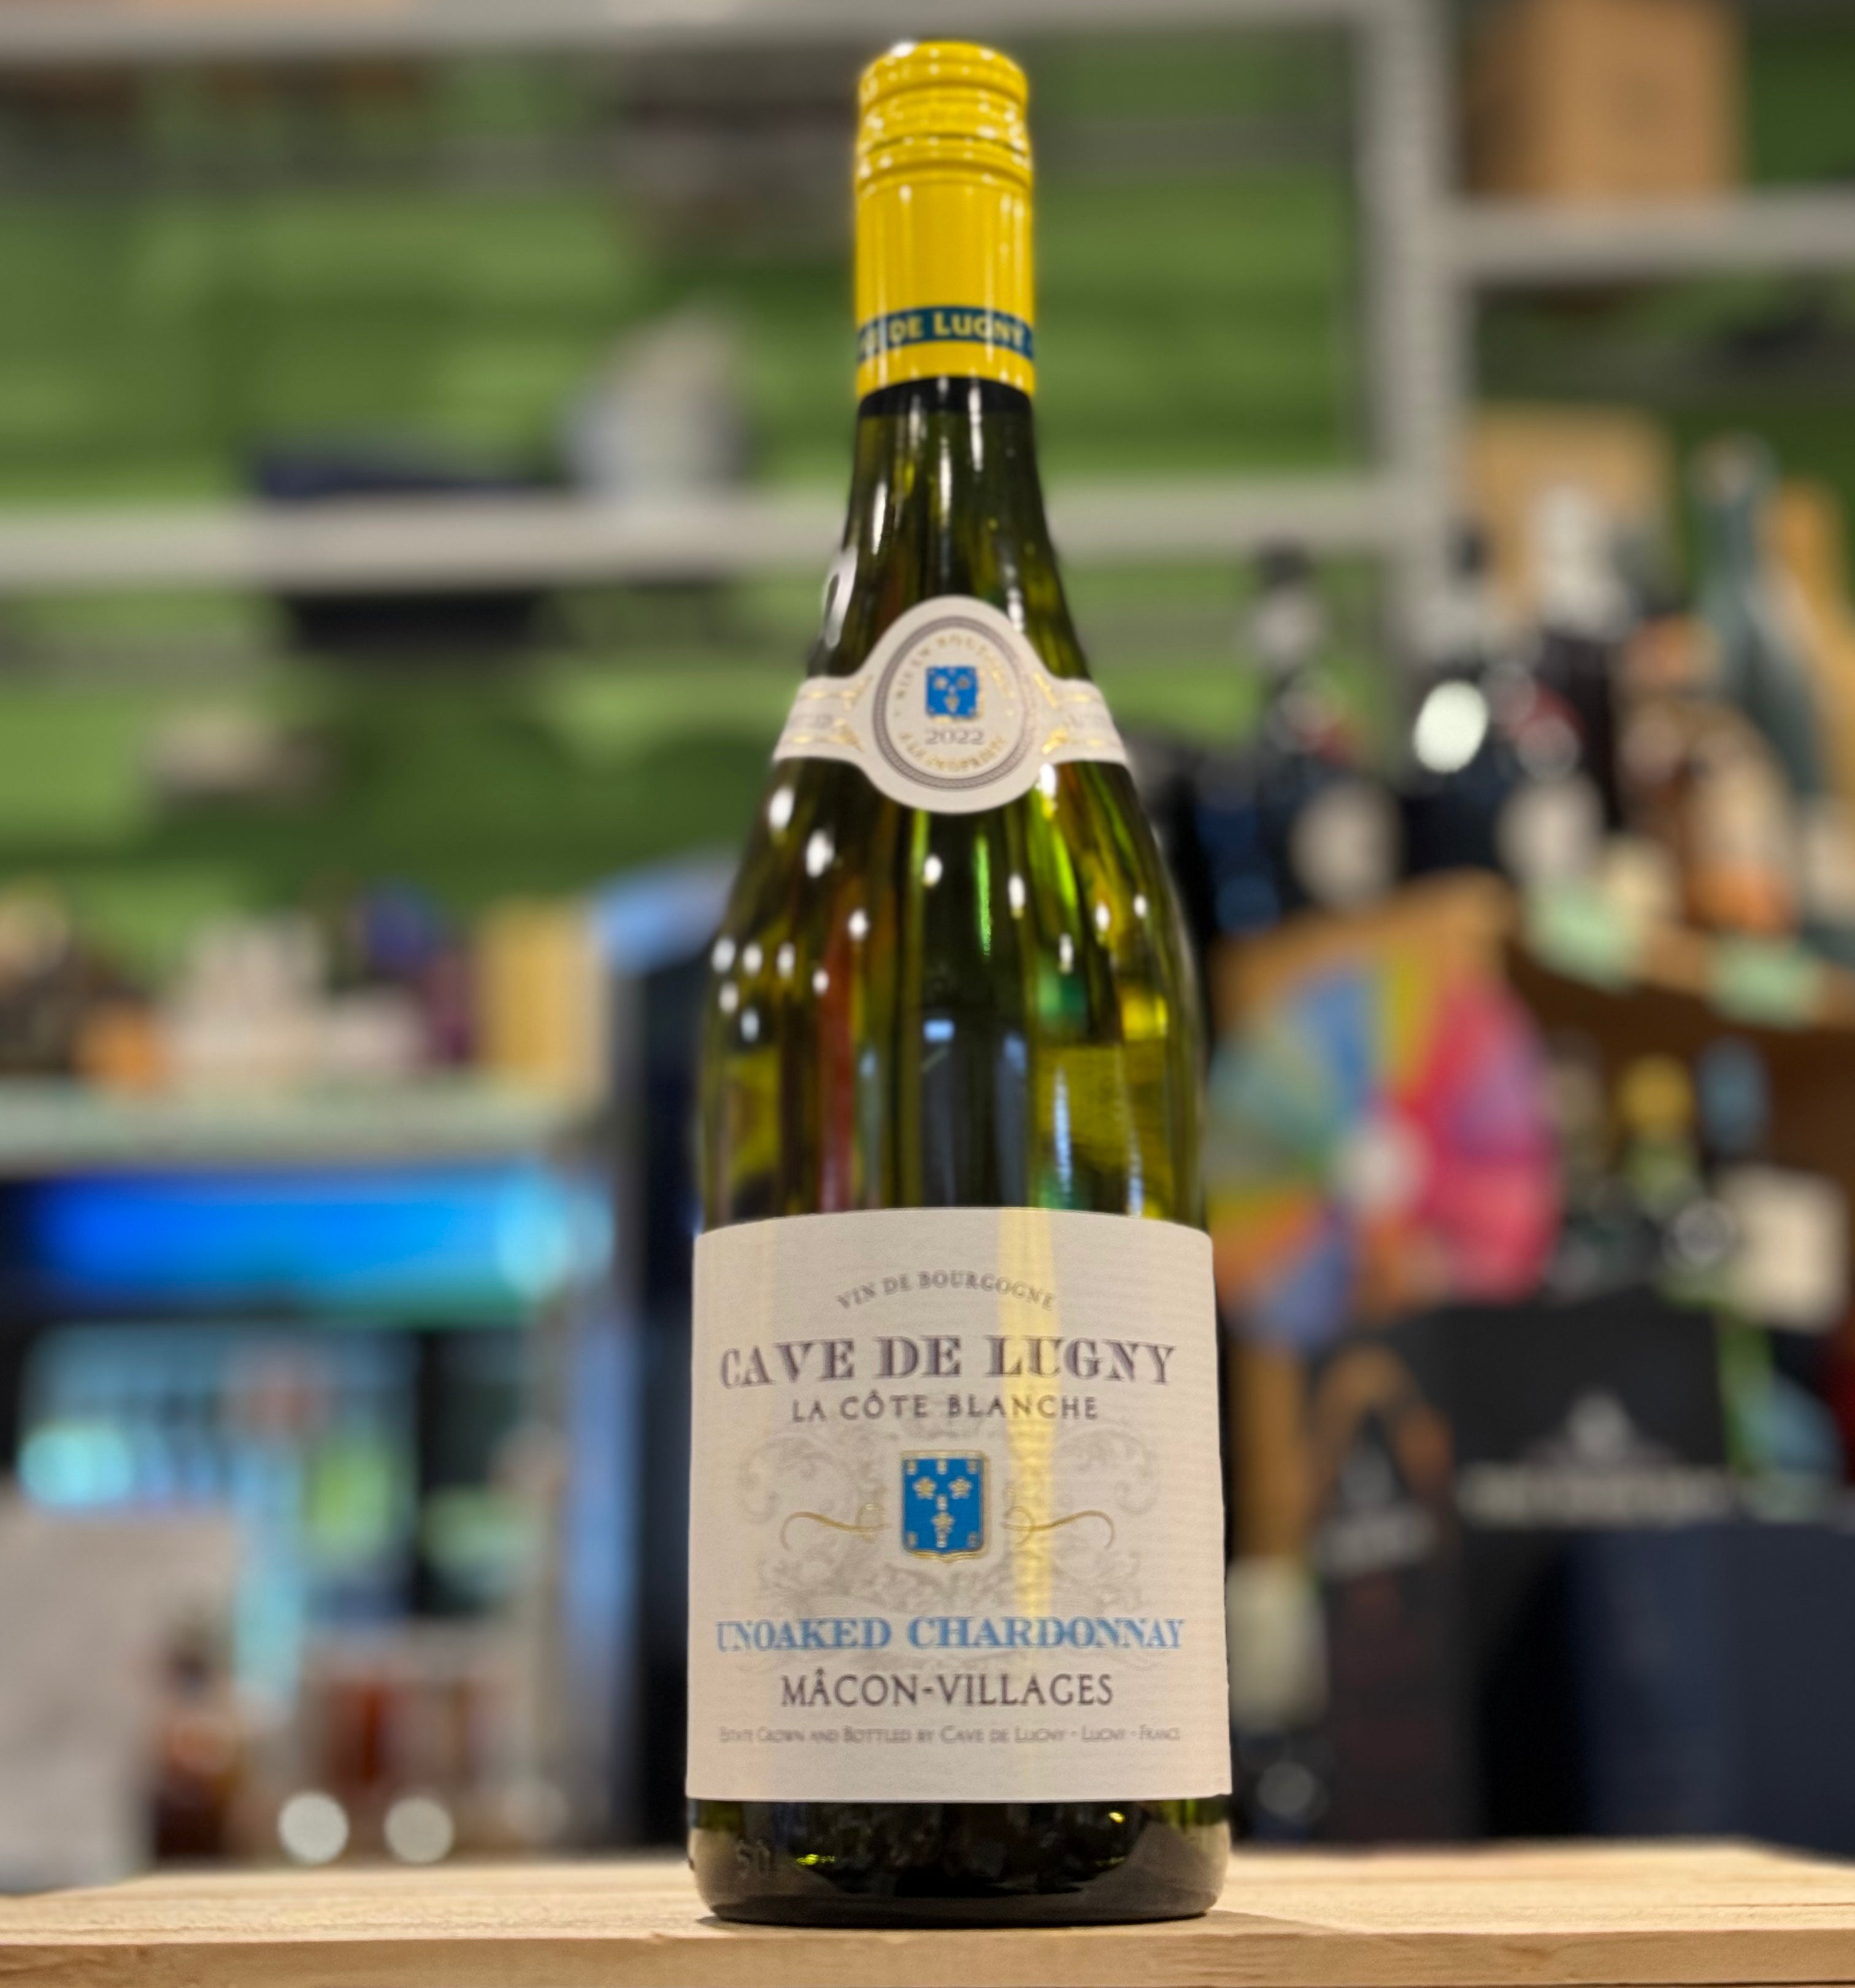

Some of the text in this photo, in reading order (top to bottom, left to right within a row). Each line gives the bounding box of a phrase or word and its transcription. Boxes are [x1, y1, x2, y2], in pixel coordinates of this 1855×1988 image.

[889, 315, 923, 343] DE
[925, 726, 984, 746] 2022
[835, 1269, 1055, 1311] VIN DE BOURGOGNE
[720, 1334, 1177, 1389] CAVE DE LUGNY
[792, 1389, 1098, 1422] LA CÔTE BLANCHE
[715, 1616, 1185, 1652] UNOAKED CHARDONNAY
[781, 1666, 1113, 1707] MÂCON-VILLAGES
